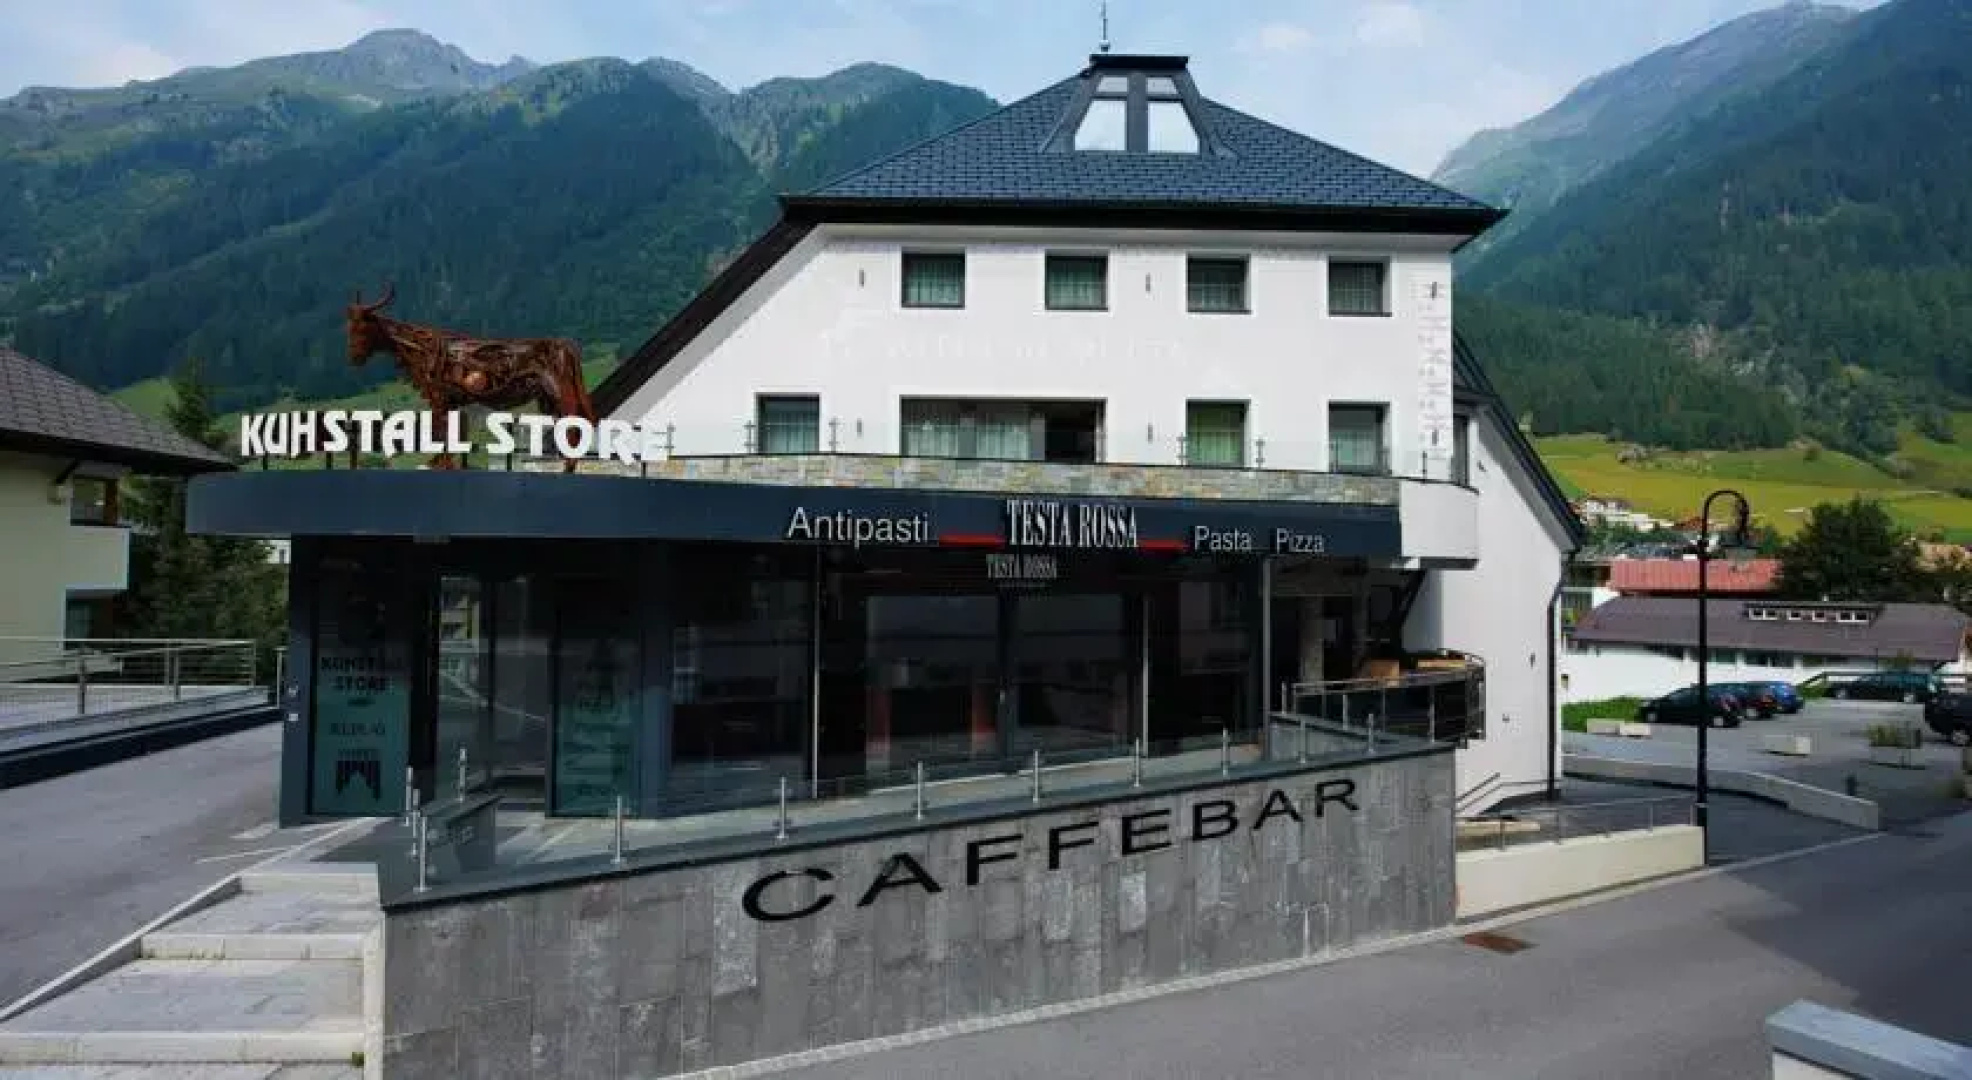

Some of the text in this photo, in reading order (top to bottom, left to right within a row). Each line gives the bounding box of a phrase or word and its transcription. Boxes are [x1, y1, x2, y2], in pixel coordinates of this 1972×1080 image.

[241, 410, 669, 465] KUHSTALL STORE
[787, 506, 929, 548] Antipasti
[1007, 499, 1138, 548] TESTA ROSSA
[1194, 525, 1252, 553] Pasta
[1276, 527, 1325, 554] Pizza
[742, 778, 1361, 922] CAFFEBAR
